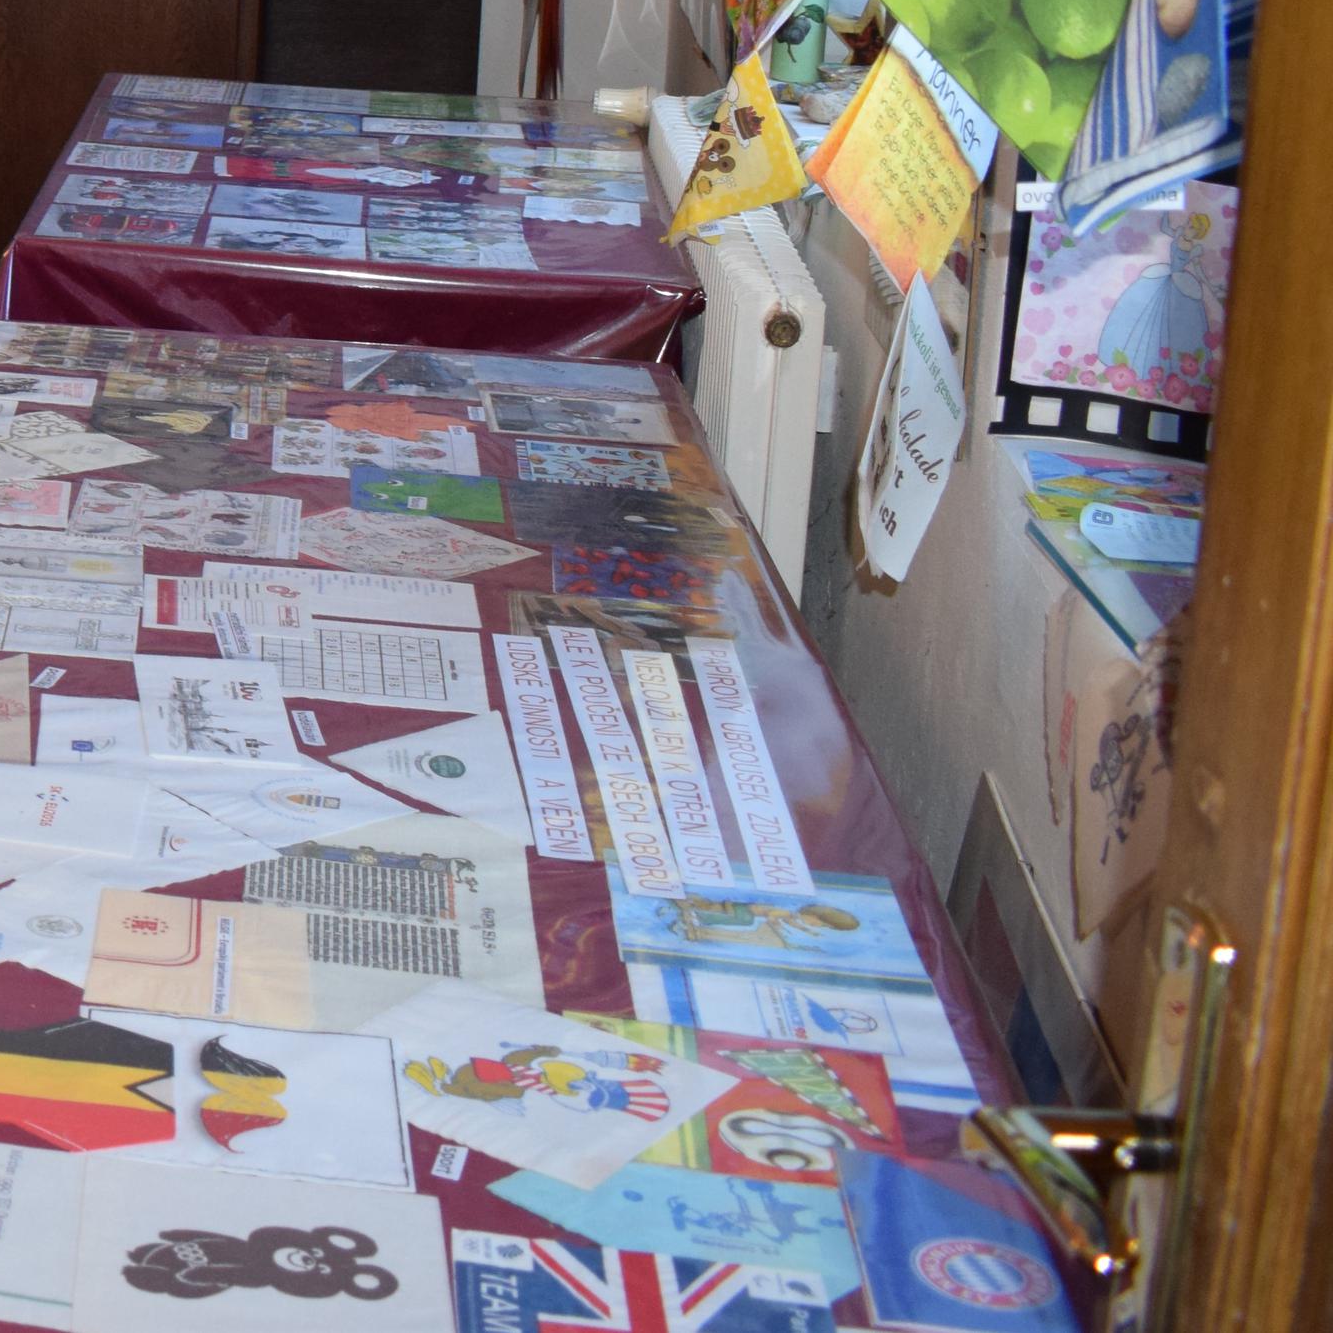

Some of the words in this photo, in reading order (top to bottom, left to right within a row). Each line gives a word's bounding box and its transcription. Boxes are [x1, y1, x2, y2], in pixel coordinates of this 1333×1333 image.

[505, 639, 542, 689] LIDSKÉ
[557, 628, 594, 655] ALE
[571, 656, 599, 671] K
[575, 674, 630, 738] POUČENÍ
[631, 654, 685, 724] NESLOUŽÍ
[699, 648, 751, 716] PAPÍROVÝ
[517, 692, 562, 761] ČINNOSTI
[598, 742, 634, 764] ZE
[651, 726, 688, 757] JEN
[534, 776, 566, 789] A
[661, 759, 693, 775] K
[720, 722, 772, 806] UBROUSEK
[606, 771, 652, 825] VŠECH
[666, 779, 712, 841] OTŘENÍ
[540, 797, 587, 856] VĚDĚNÍ
[745, 813, 800, 888] ZDALEKA
[624, 831, 680, 894] OBORŮ
[440, 1145, 458, 1175] sport
